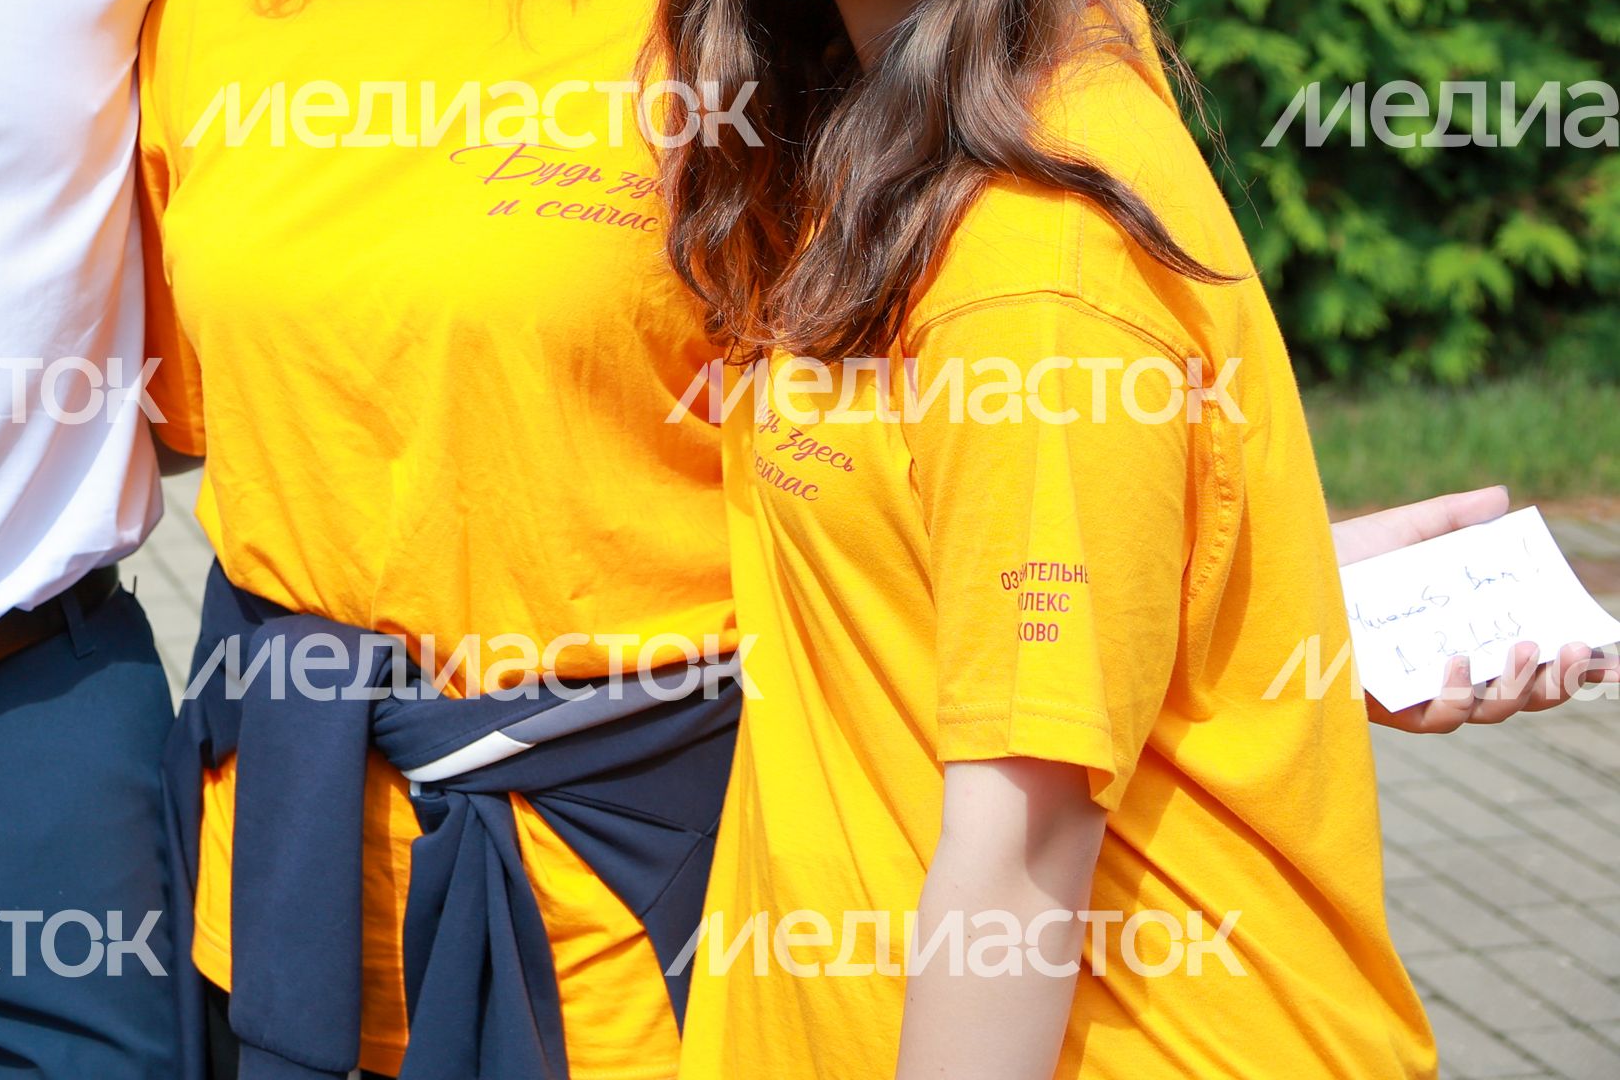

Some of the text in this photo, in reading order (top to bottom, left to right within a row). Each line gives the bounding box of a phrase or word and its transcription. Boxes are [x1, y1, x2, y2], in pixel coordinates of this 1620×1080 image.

[449, 142, 602, 186] Будь
[487, 199, 661, 233] и сейчас
[776, 426, 856, 473] здесь
[754, 453, 820, 501] ейчас
